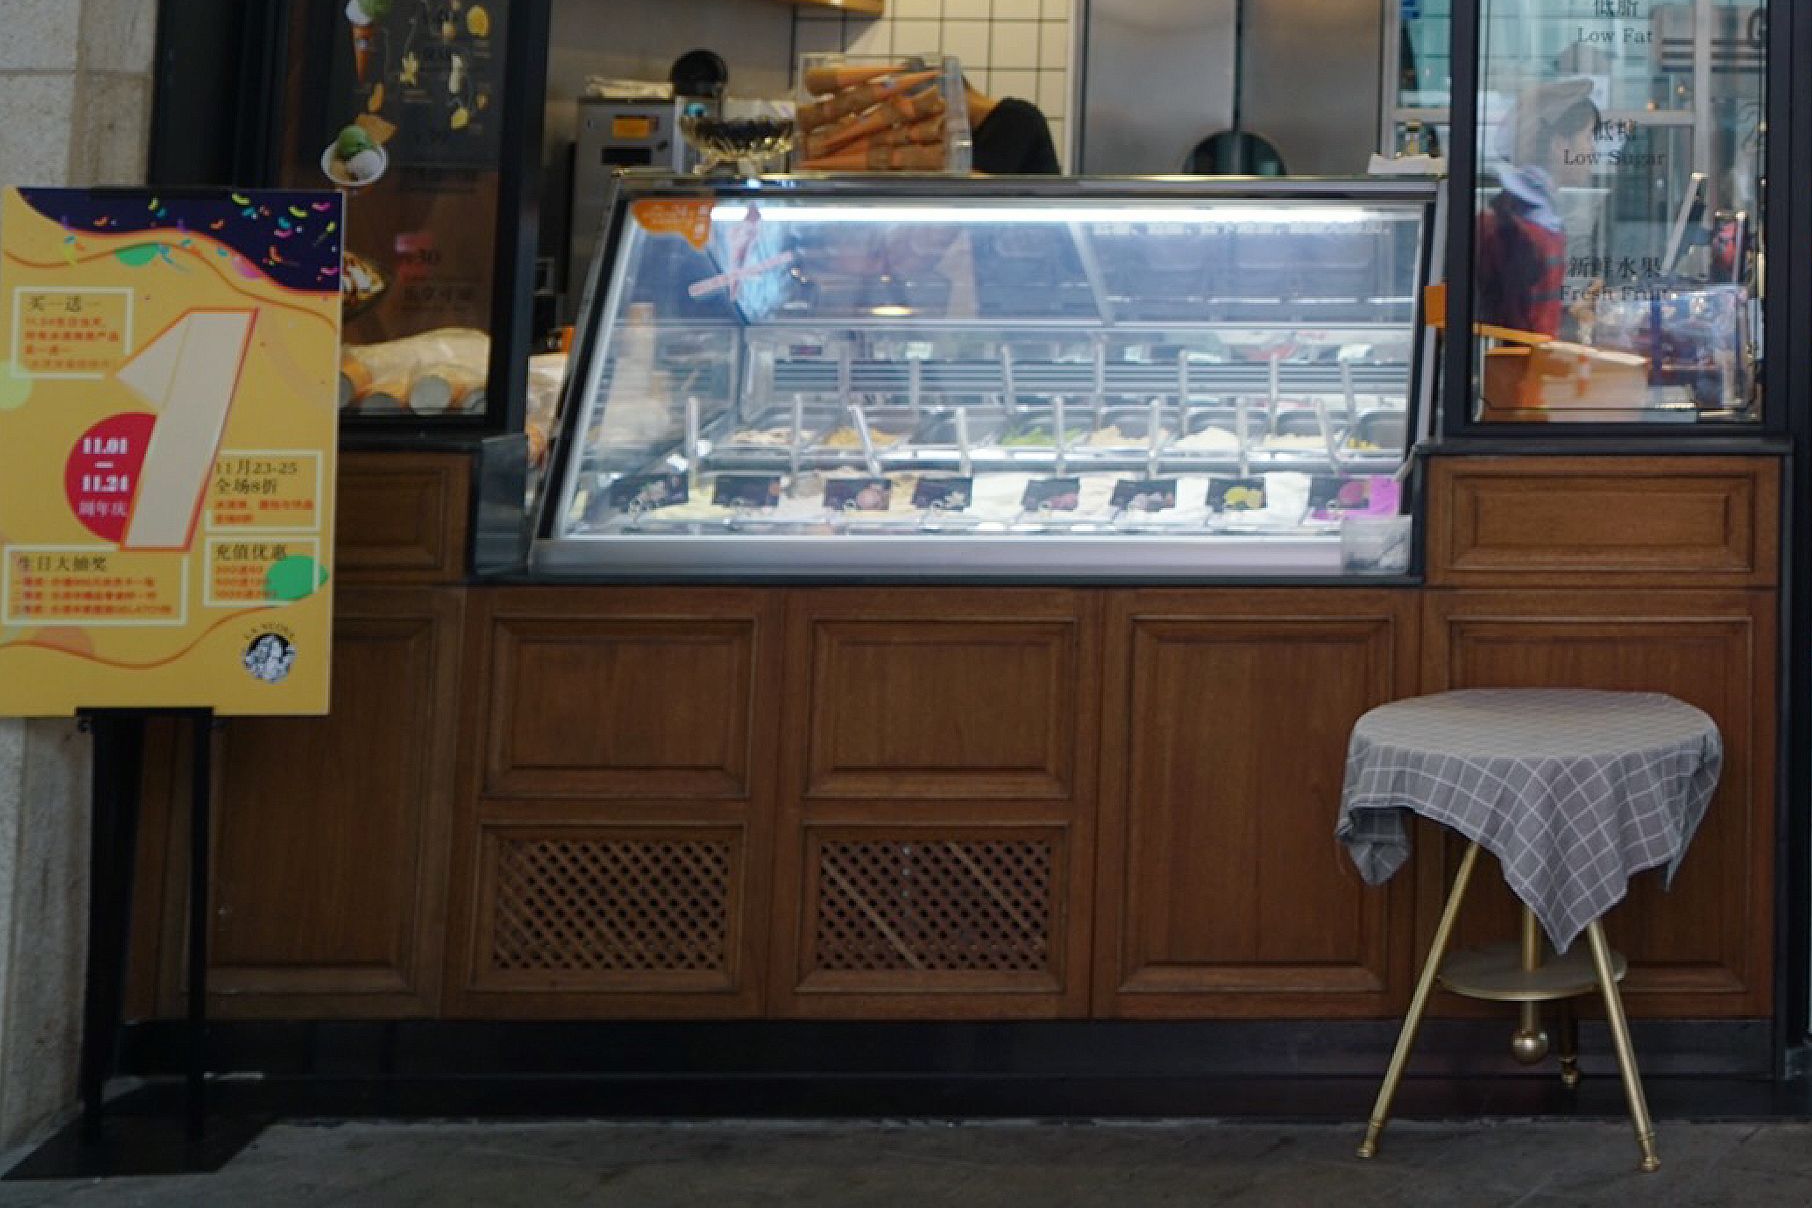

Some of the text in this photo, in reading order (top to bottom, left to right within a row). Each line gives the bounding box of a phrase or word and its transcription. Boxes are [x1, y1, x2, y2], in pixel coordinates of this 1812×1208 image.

[1576, 27, 1654, 44] Low Fat
[1563, 148, 1599, 166] Low
